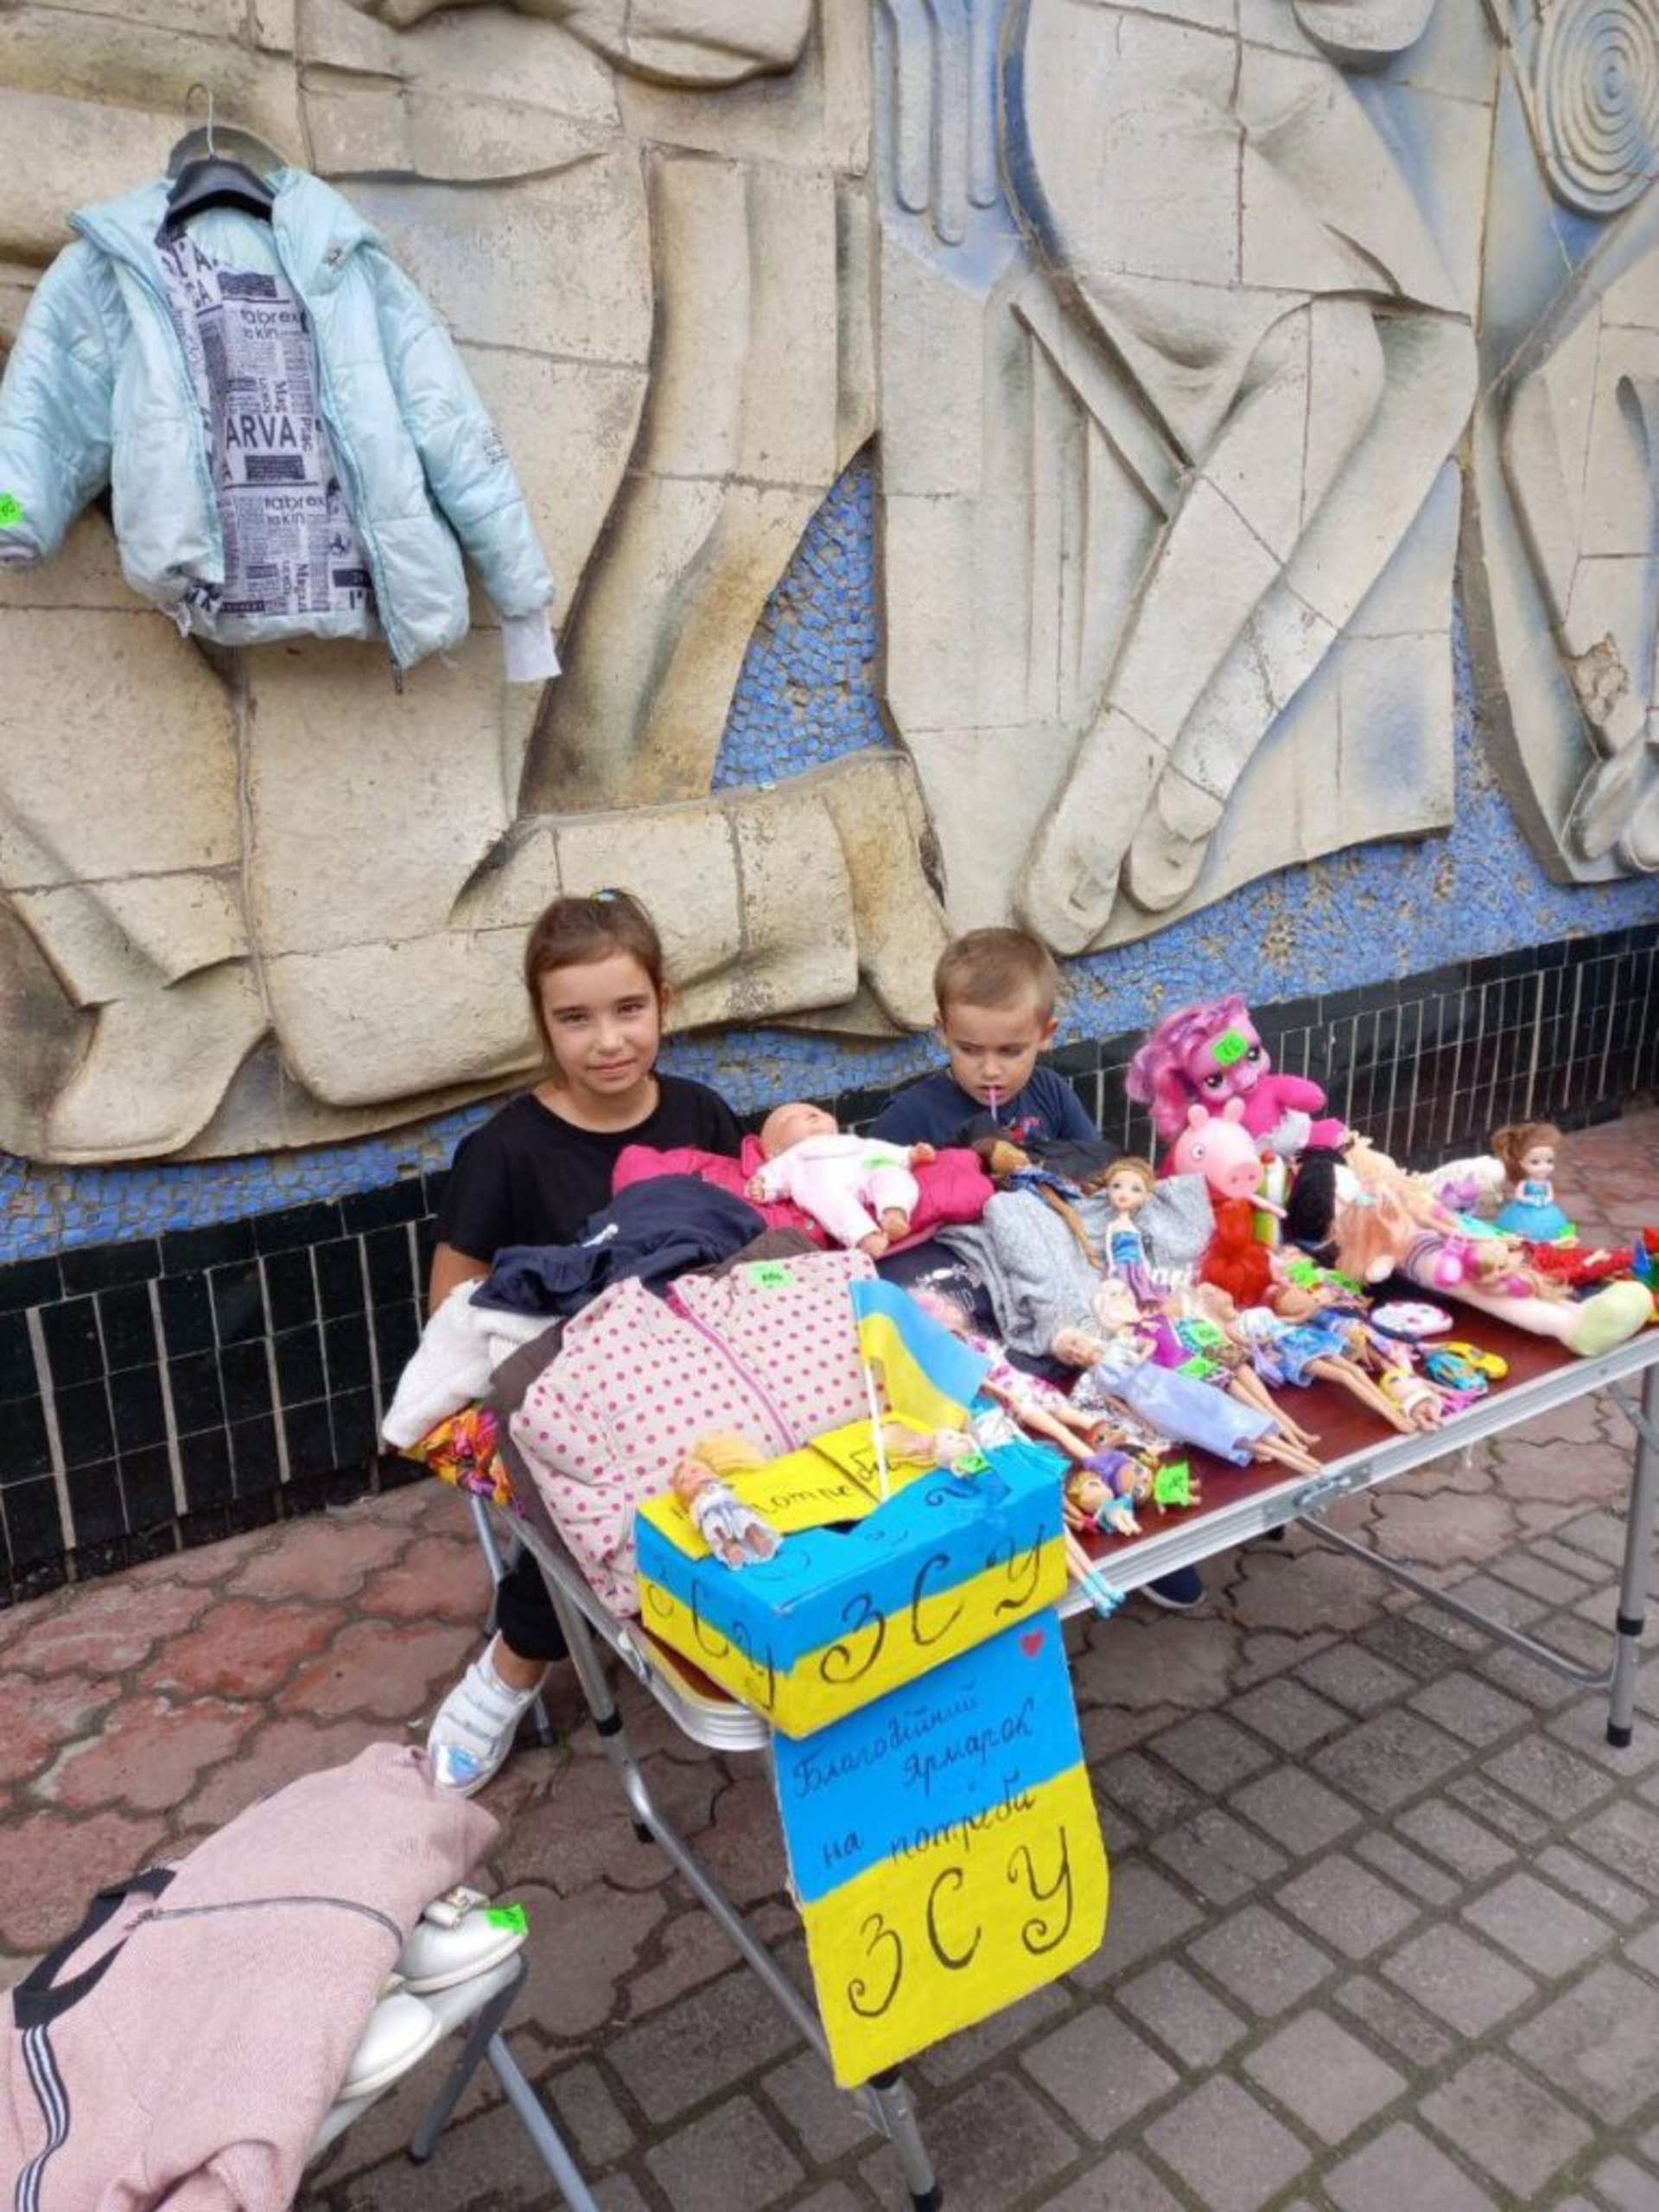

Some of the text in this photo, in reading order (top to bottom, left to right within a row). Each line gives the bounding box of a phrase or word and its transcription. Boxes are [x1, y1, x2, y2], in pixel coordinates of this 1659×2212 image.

[225, 414, 298, 450] ARVA
[820, 1522, 1046, 1685] ЗСУ
[823, 1769, 1036, 1869] на потреби
[847, 1825, 1073, 2018] ЗСУ
